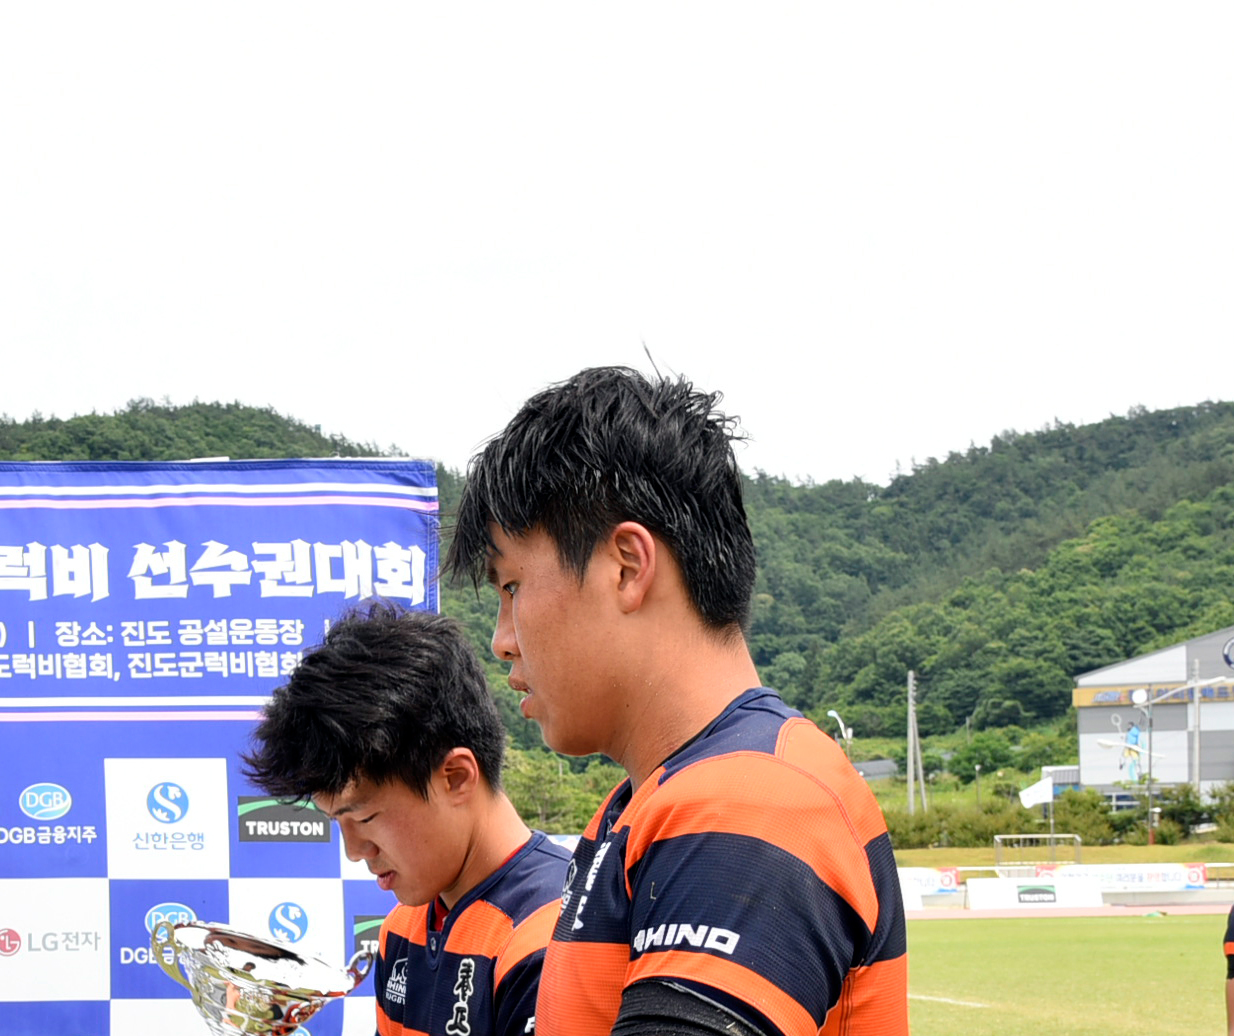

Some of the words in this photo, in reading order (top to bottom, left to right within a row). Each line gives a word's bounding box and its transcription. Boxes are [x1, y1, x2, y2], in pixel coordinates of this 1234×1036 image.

[126, 537, 427, 607] 선수권대회
[55, 619, 114, 648] 장소:
[120, 619, 172, 647] 진도
[177, 618, 305, 647] 공설운동장
[26, 791, 64, 809] DGB
[246, 820, 324, 837] TRUSTON
[132, 831, 205, 852] 신한은행
[27, 931, 101, 952] LG전자
